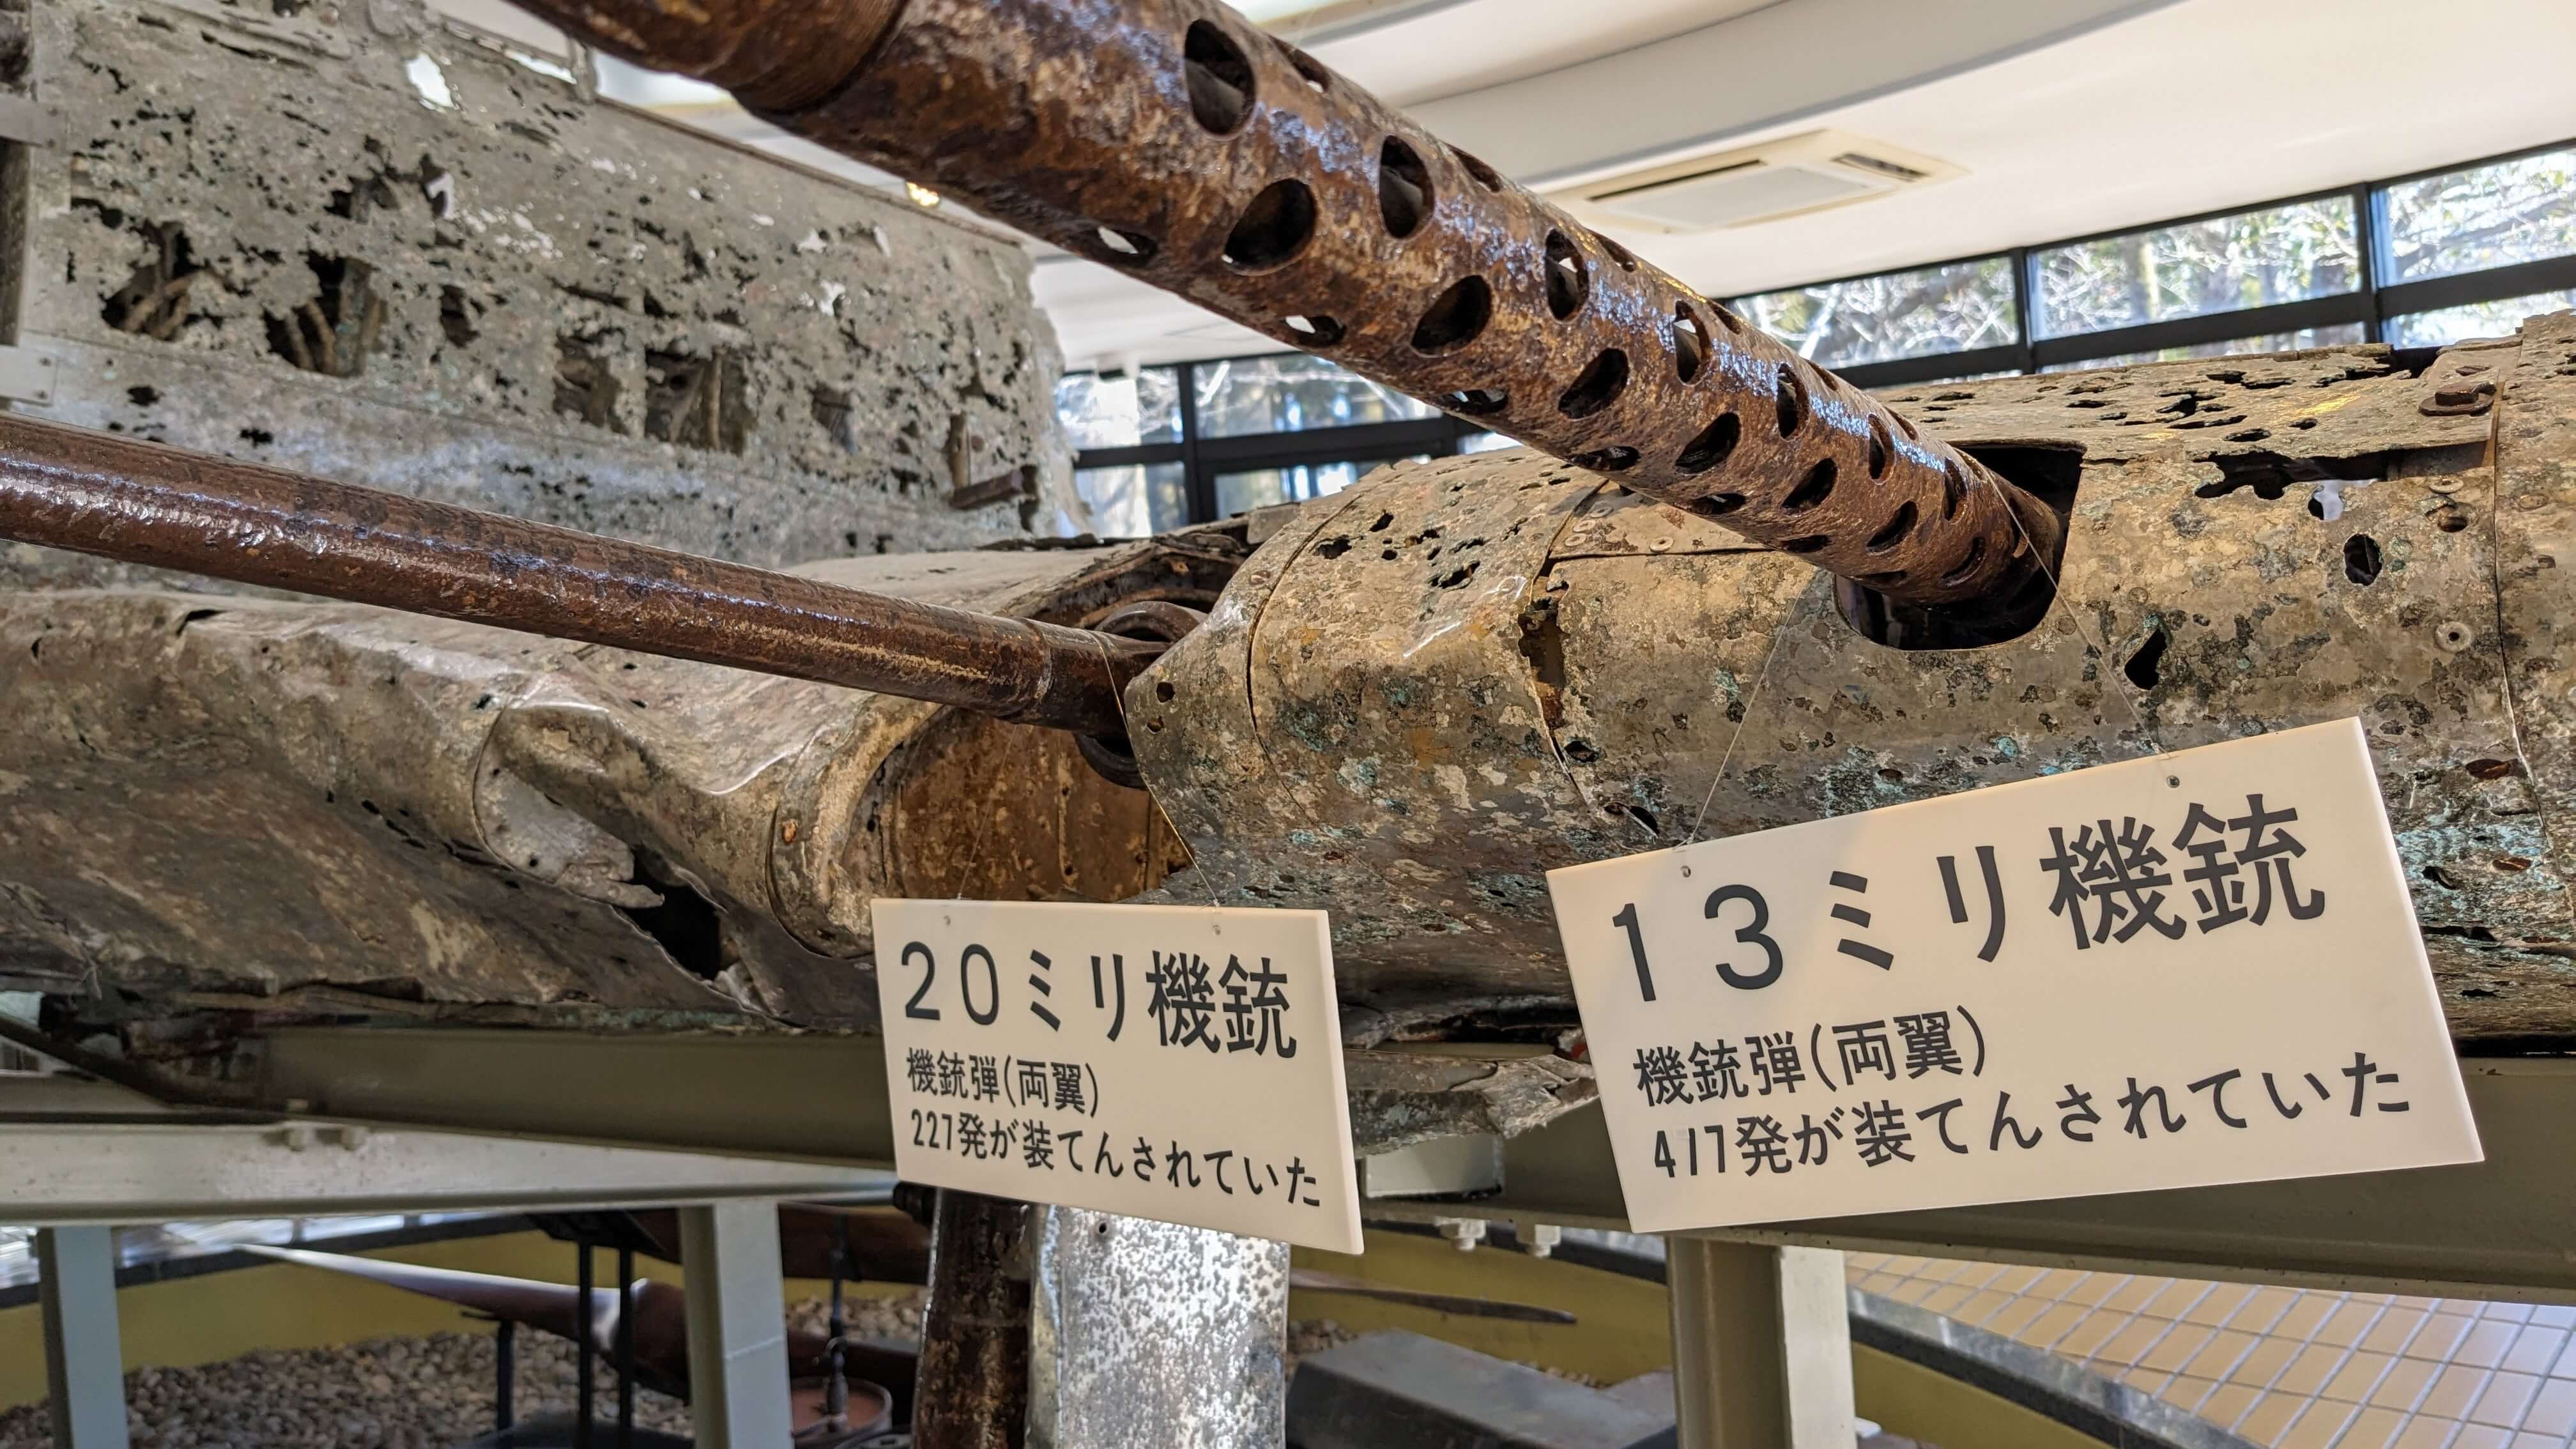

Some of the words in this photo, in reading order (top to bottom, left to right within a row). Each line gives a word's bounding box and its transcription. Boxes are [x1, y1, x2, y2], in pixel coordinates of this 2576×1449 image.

[1613, 794, 2325, 1002] 13ミリ機銃
[901, 942, 1296, 1058] 20ミリ機銃
[907, 1048, 1098, 1117] 機銃弾(両翼)
[1633, 1006, 1984, 1107] 機銃弾(両翼)
[912, 1109, 1319, 1206] 227発が装てんされていた
[1655, 1052, 2409, 1177] 417発が装てんされていた
